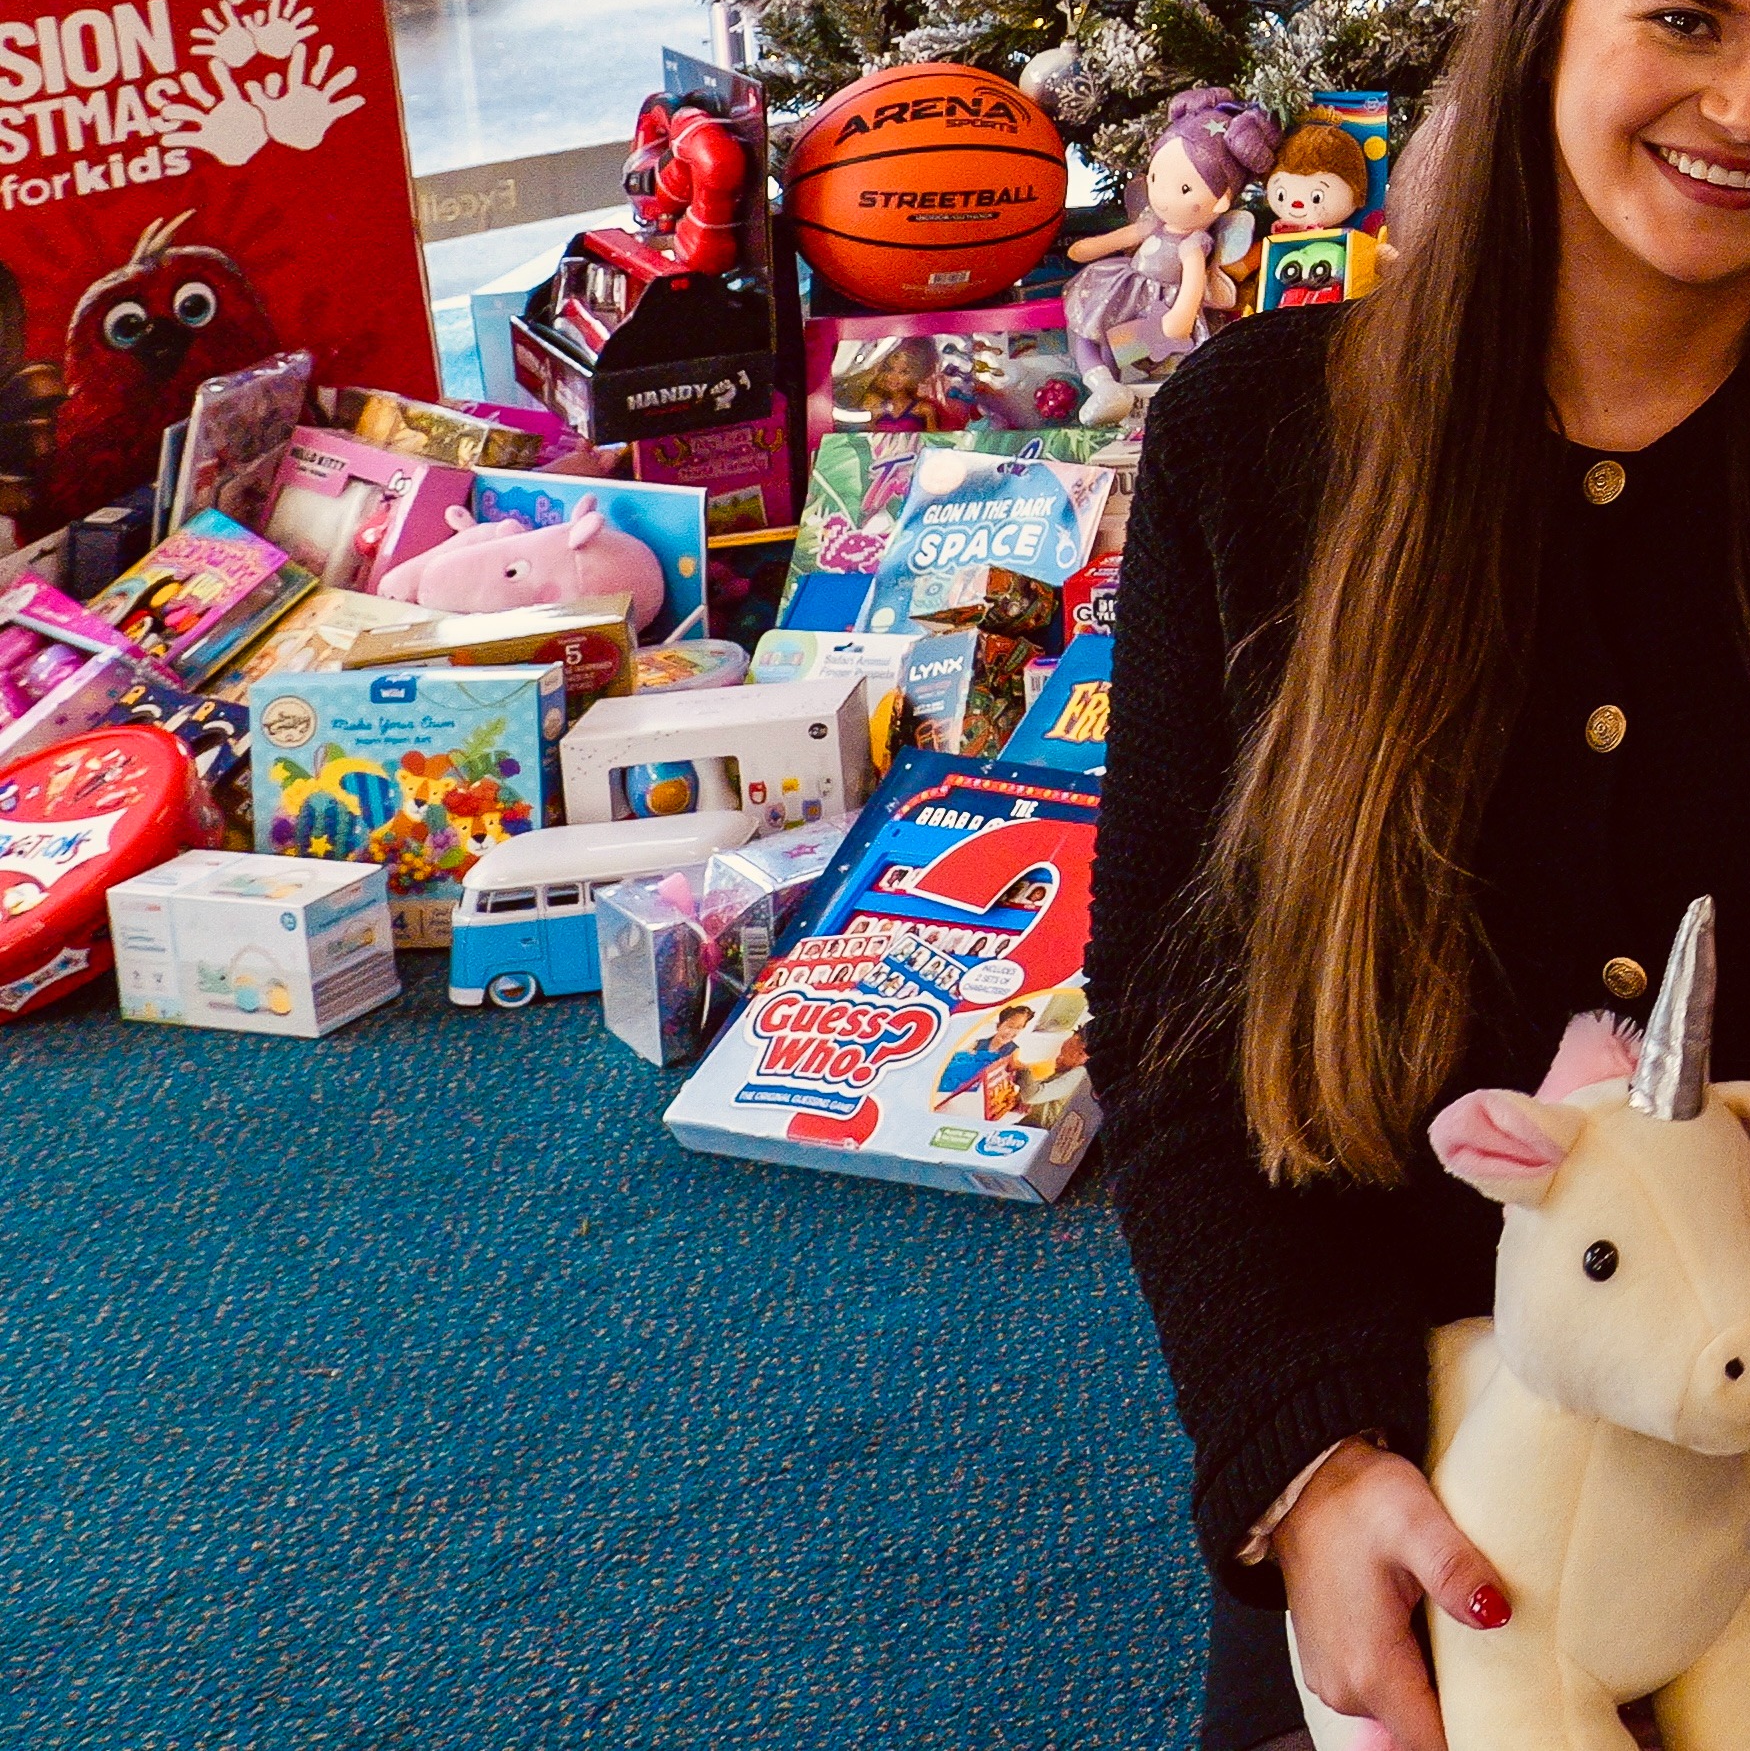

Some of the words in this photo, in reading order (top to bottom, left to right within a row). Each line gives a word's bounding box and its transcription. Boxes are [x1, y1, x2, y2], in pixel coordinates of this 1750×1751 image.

[833, 95, 1019, 147] ARENA
[945, 118, 1019, 135] SPORTS
[858, 184, 1040, 210] STREETBALL
[626, 382, 710, 414] HANDY
[317, 453, 349, 472] KITTY
[921, 502, 961, 525] GLOW
[963, 500, 983, 522] IN
[983, 498, 1015, 522] THE
[1013, 496, 1058, 520] DARK
[913, 524, 1043, 568] SPACE
[564, 643, 582, 665] 5
[907, 655, 965, 683] LYNX
[760, 991, 890, 1041] Guess
